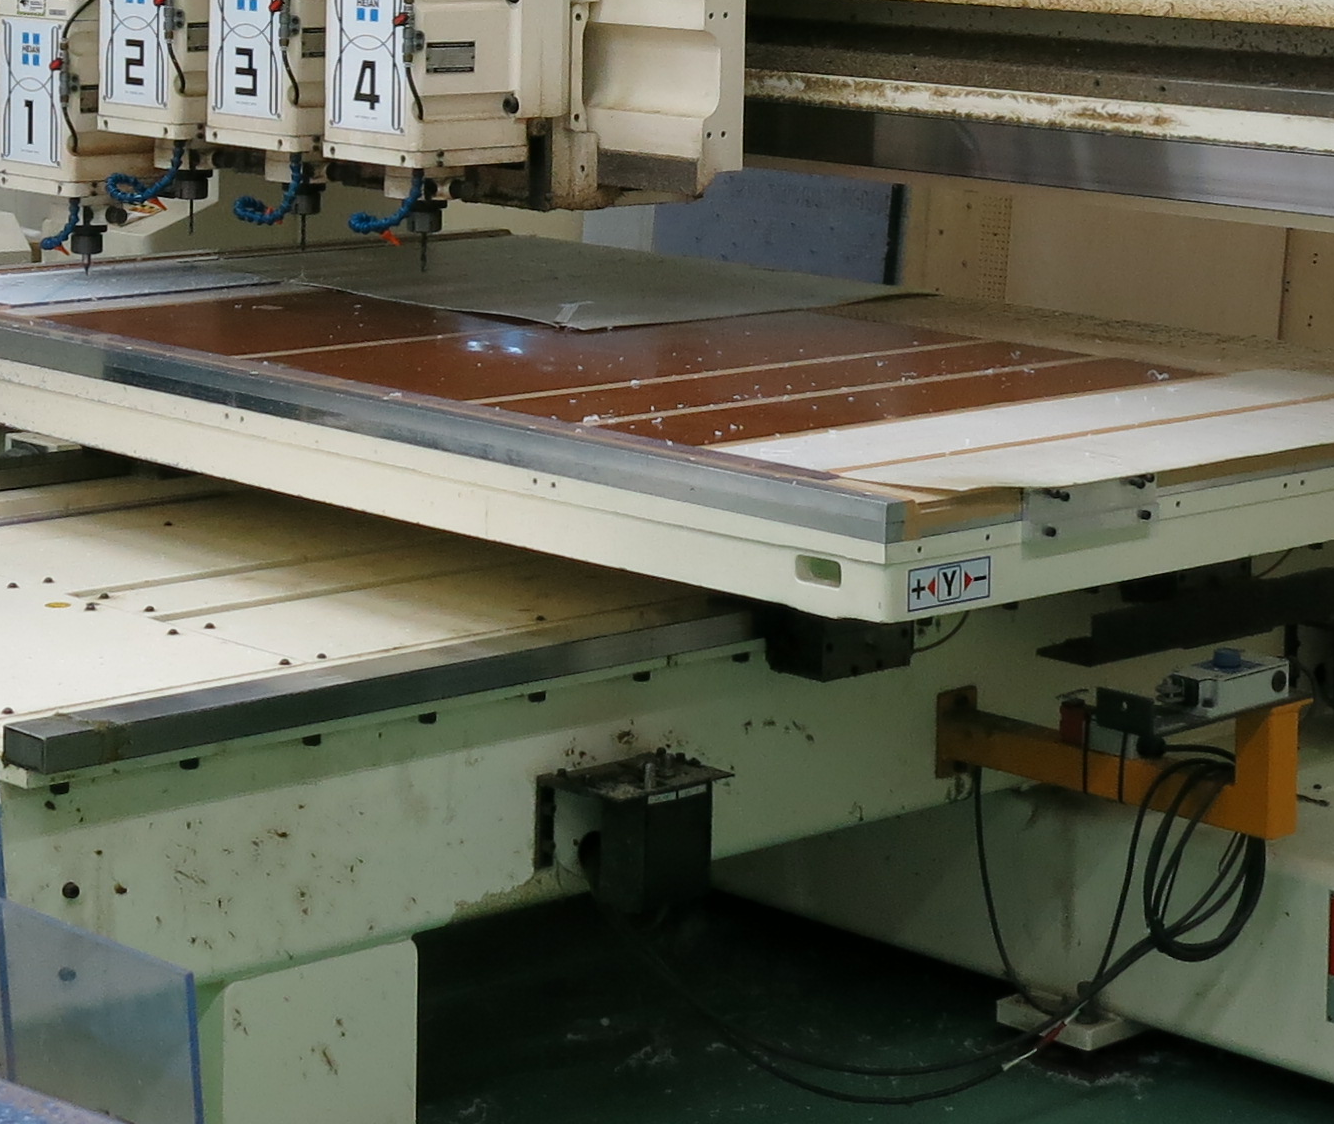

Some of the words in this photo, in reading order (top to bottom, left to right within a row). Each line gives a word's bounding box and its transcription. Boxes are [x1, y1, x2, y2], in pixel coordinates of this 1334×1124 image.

[22, 45, 41, 54] HEIAN
[125, 39, 145, 86] 2
[235, 46, 258, 97] 3
[353, 60, 380, 111] 4
[24, 99, 34, 145] 1
[941, 569, 957, 597] Y
